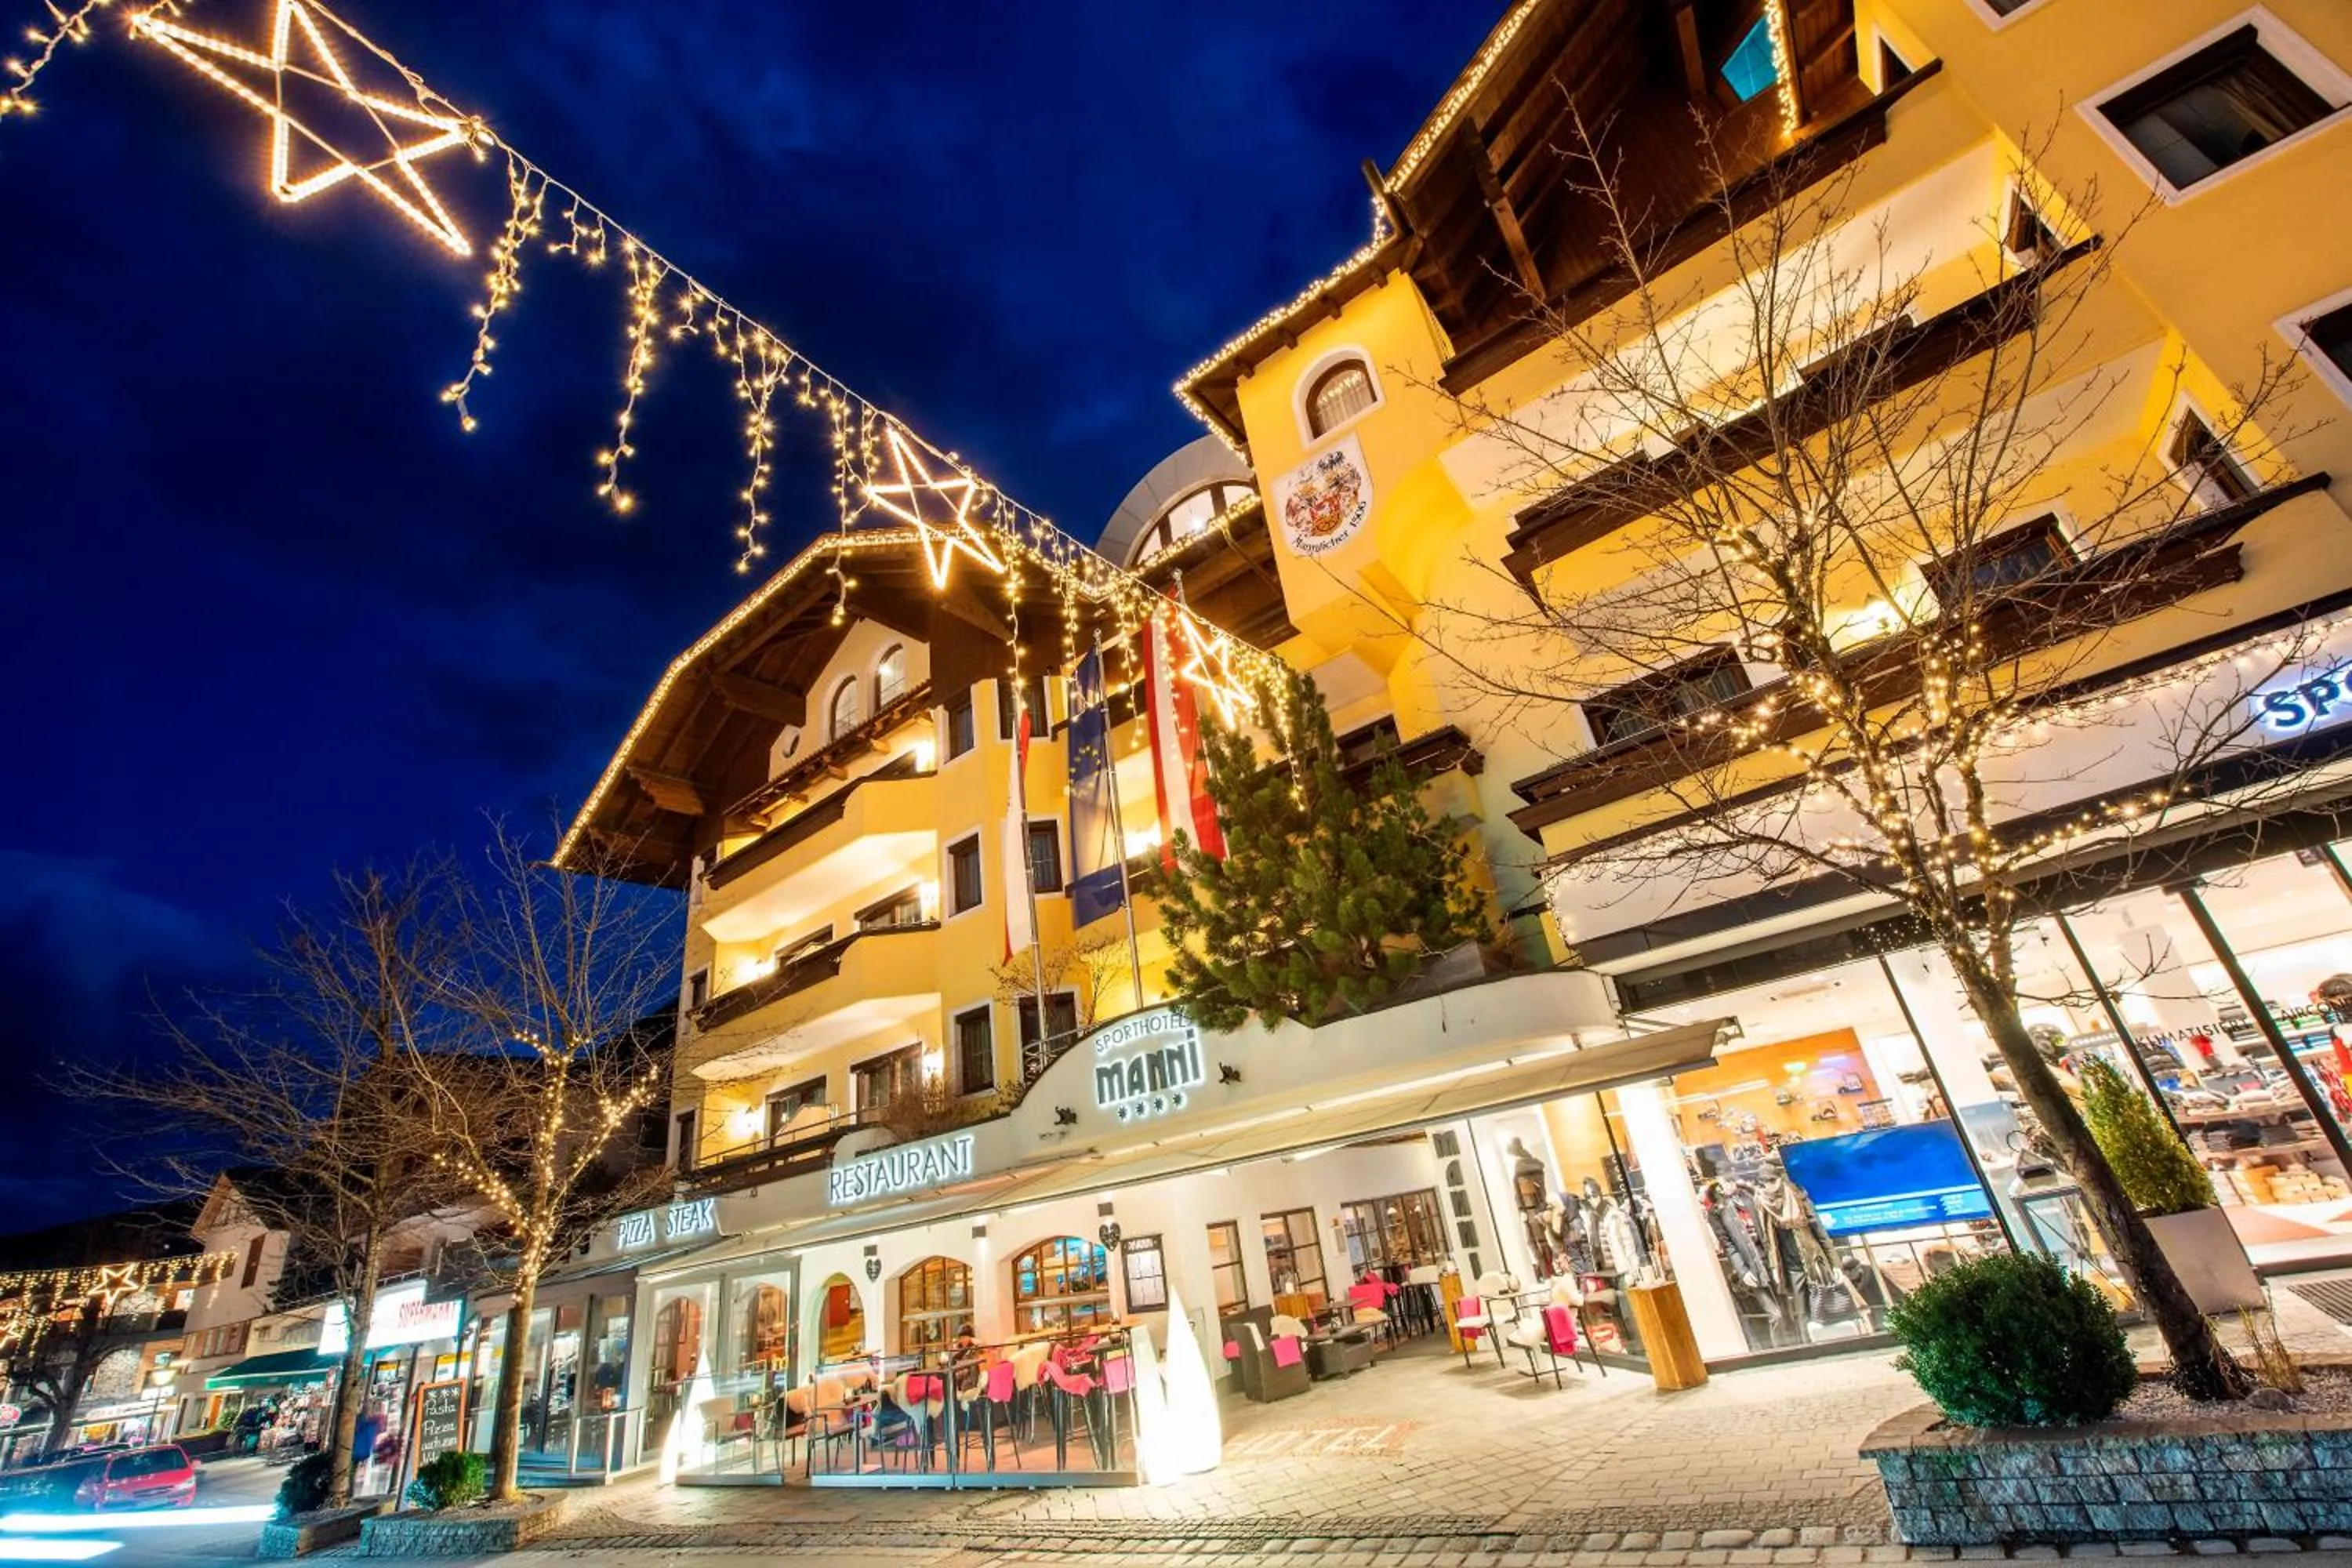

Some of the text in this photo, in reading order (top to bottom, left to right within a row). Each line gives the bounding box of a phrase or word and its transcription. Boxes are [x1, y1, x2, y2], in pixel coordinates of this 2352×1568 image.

[2263, 669, 2352, 728] SP
[1095, 1014, 1187, 1053] SPORTHOTEL
[2134, 1018, 2254, 1051] KLIMATISIERT
[830, 1138, 971, 1201] RESTAURANT
[617, 1198, 713, 1247] PIZZA STEAK
[424, 1399, 456, 1416] Pasta
